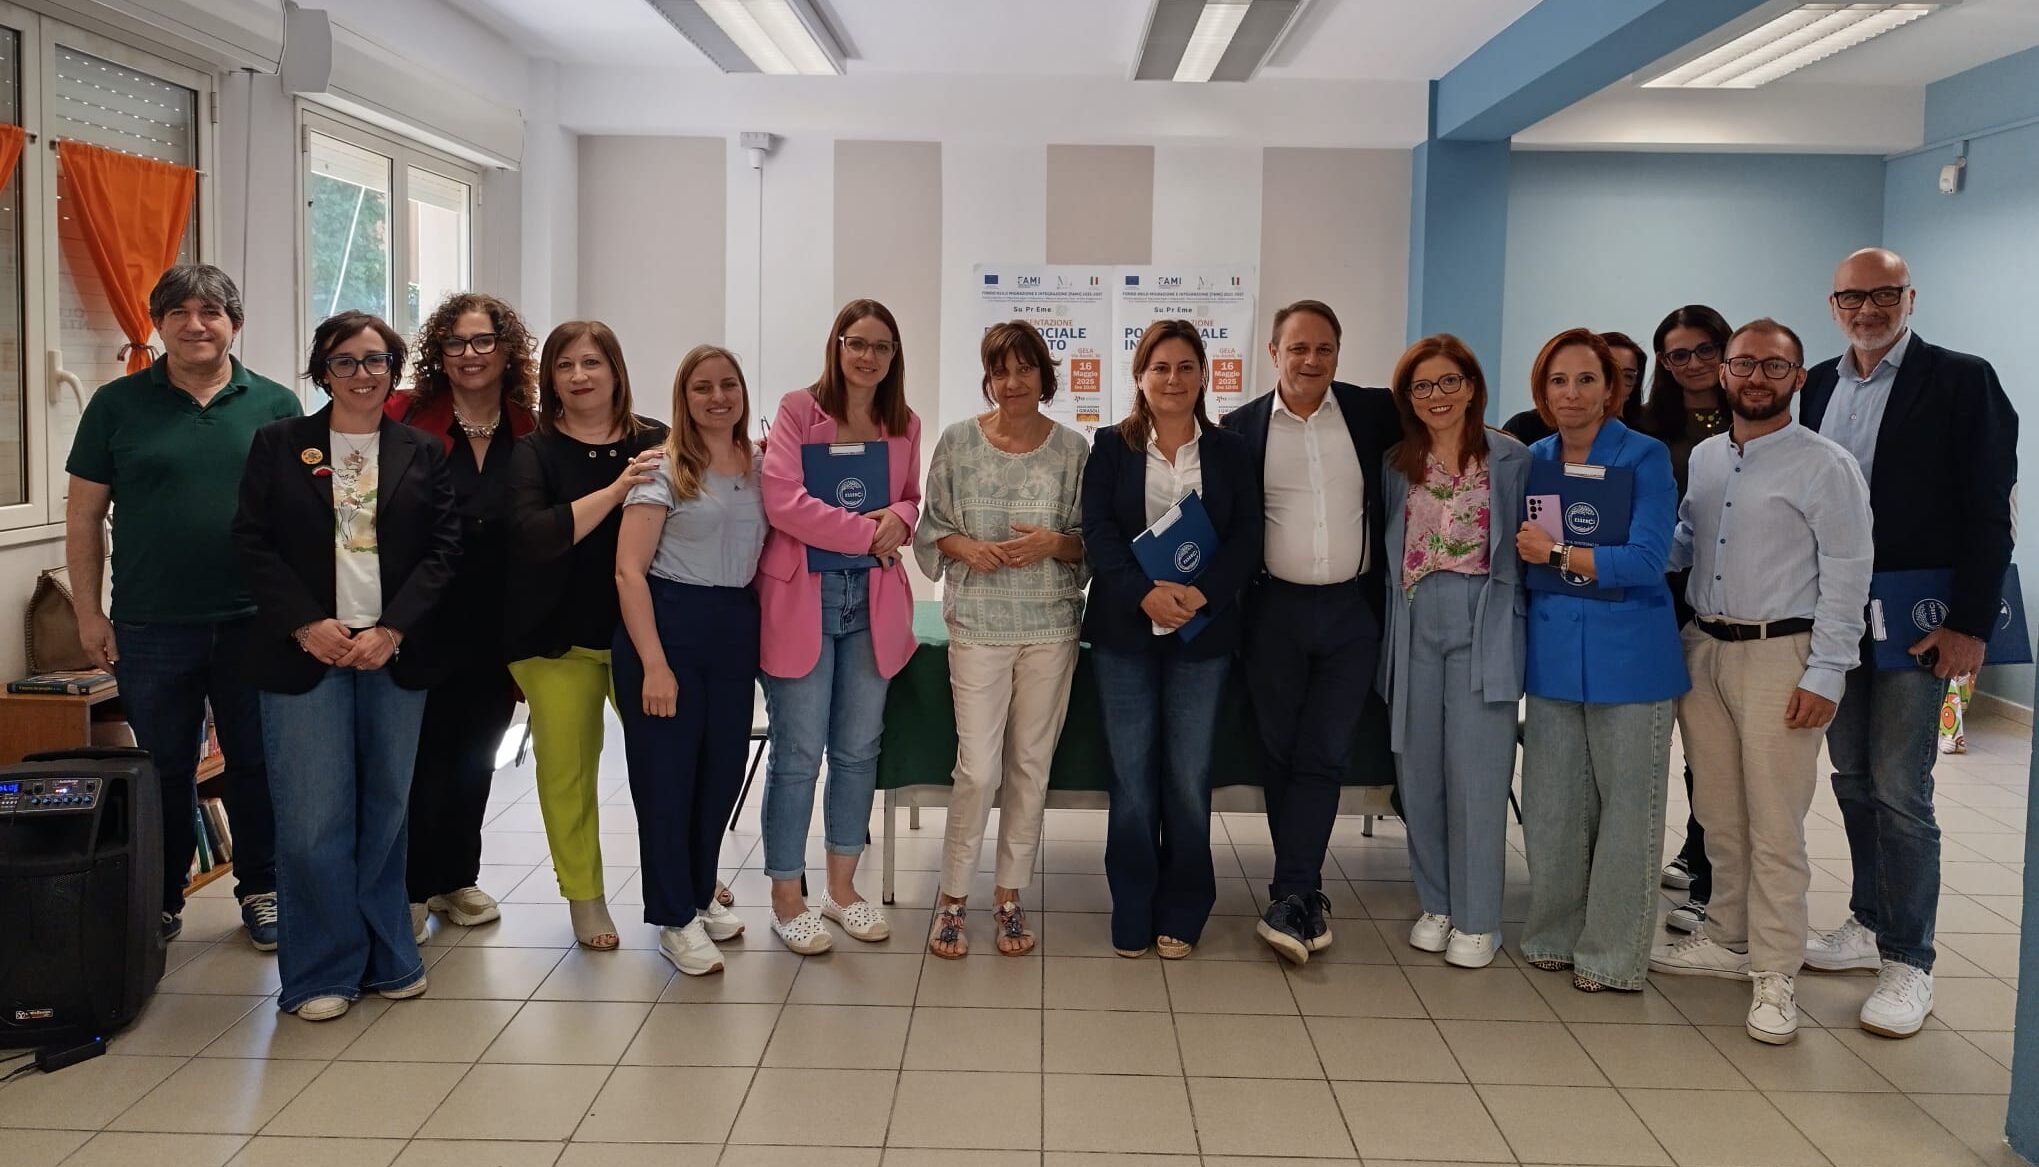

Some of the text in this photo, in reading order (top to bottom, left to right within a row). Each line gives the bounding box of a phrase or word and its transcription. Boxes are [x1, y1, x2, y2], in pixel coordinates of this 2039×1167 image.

[1017, 276, 1041, 285] FAMI
[1158, 277, 1182, 285] FAMI
[1080, 362, 1092, 370] 16
[1221, 362, 1234, 371] 16
